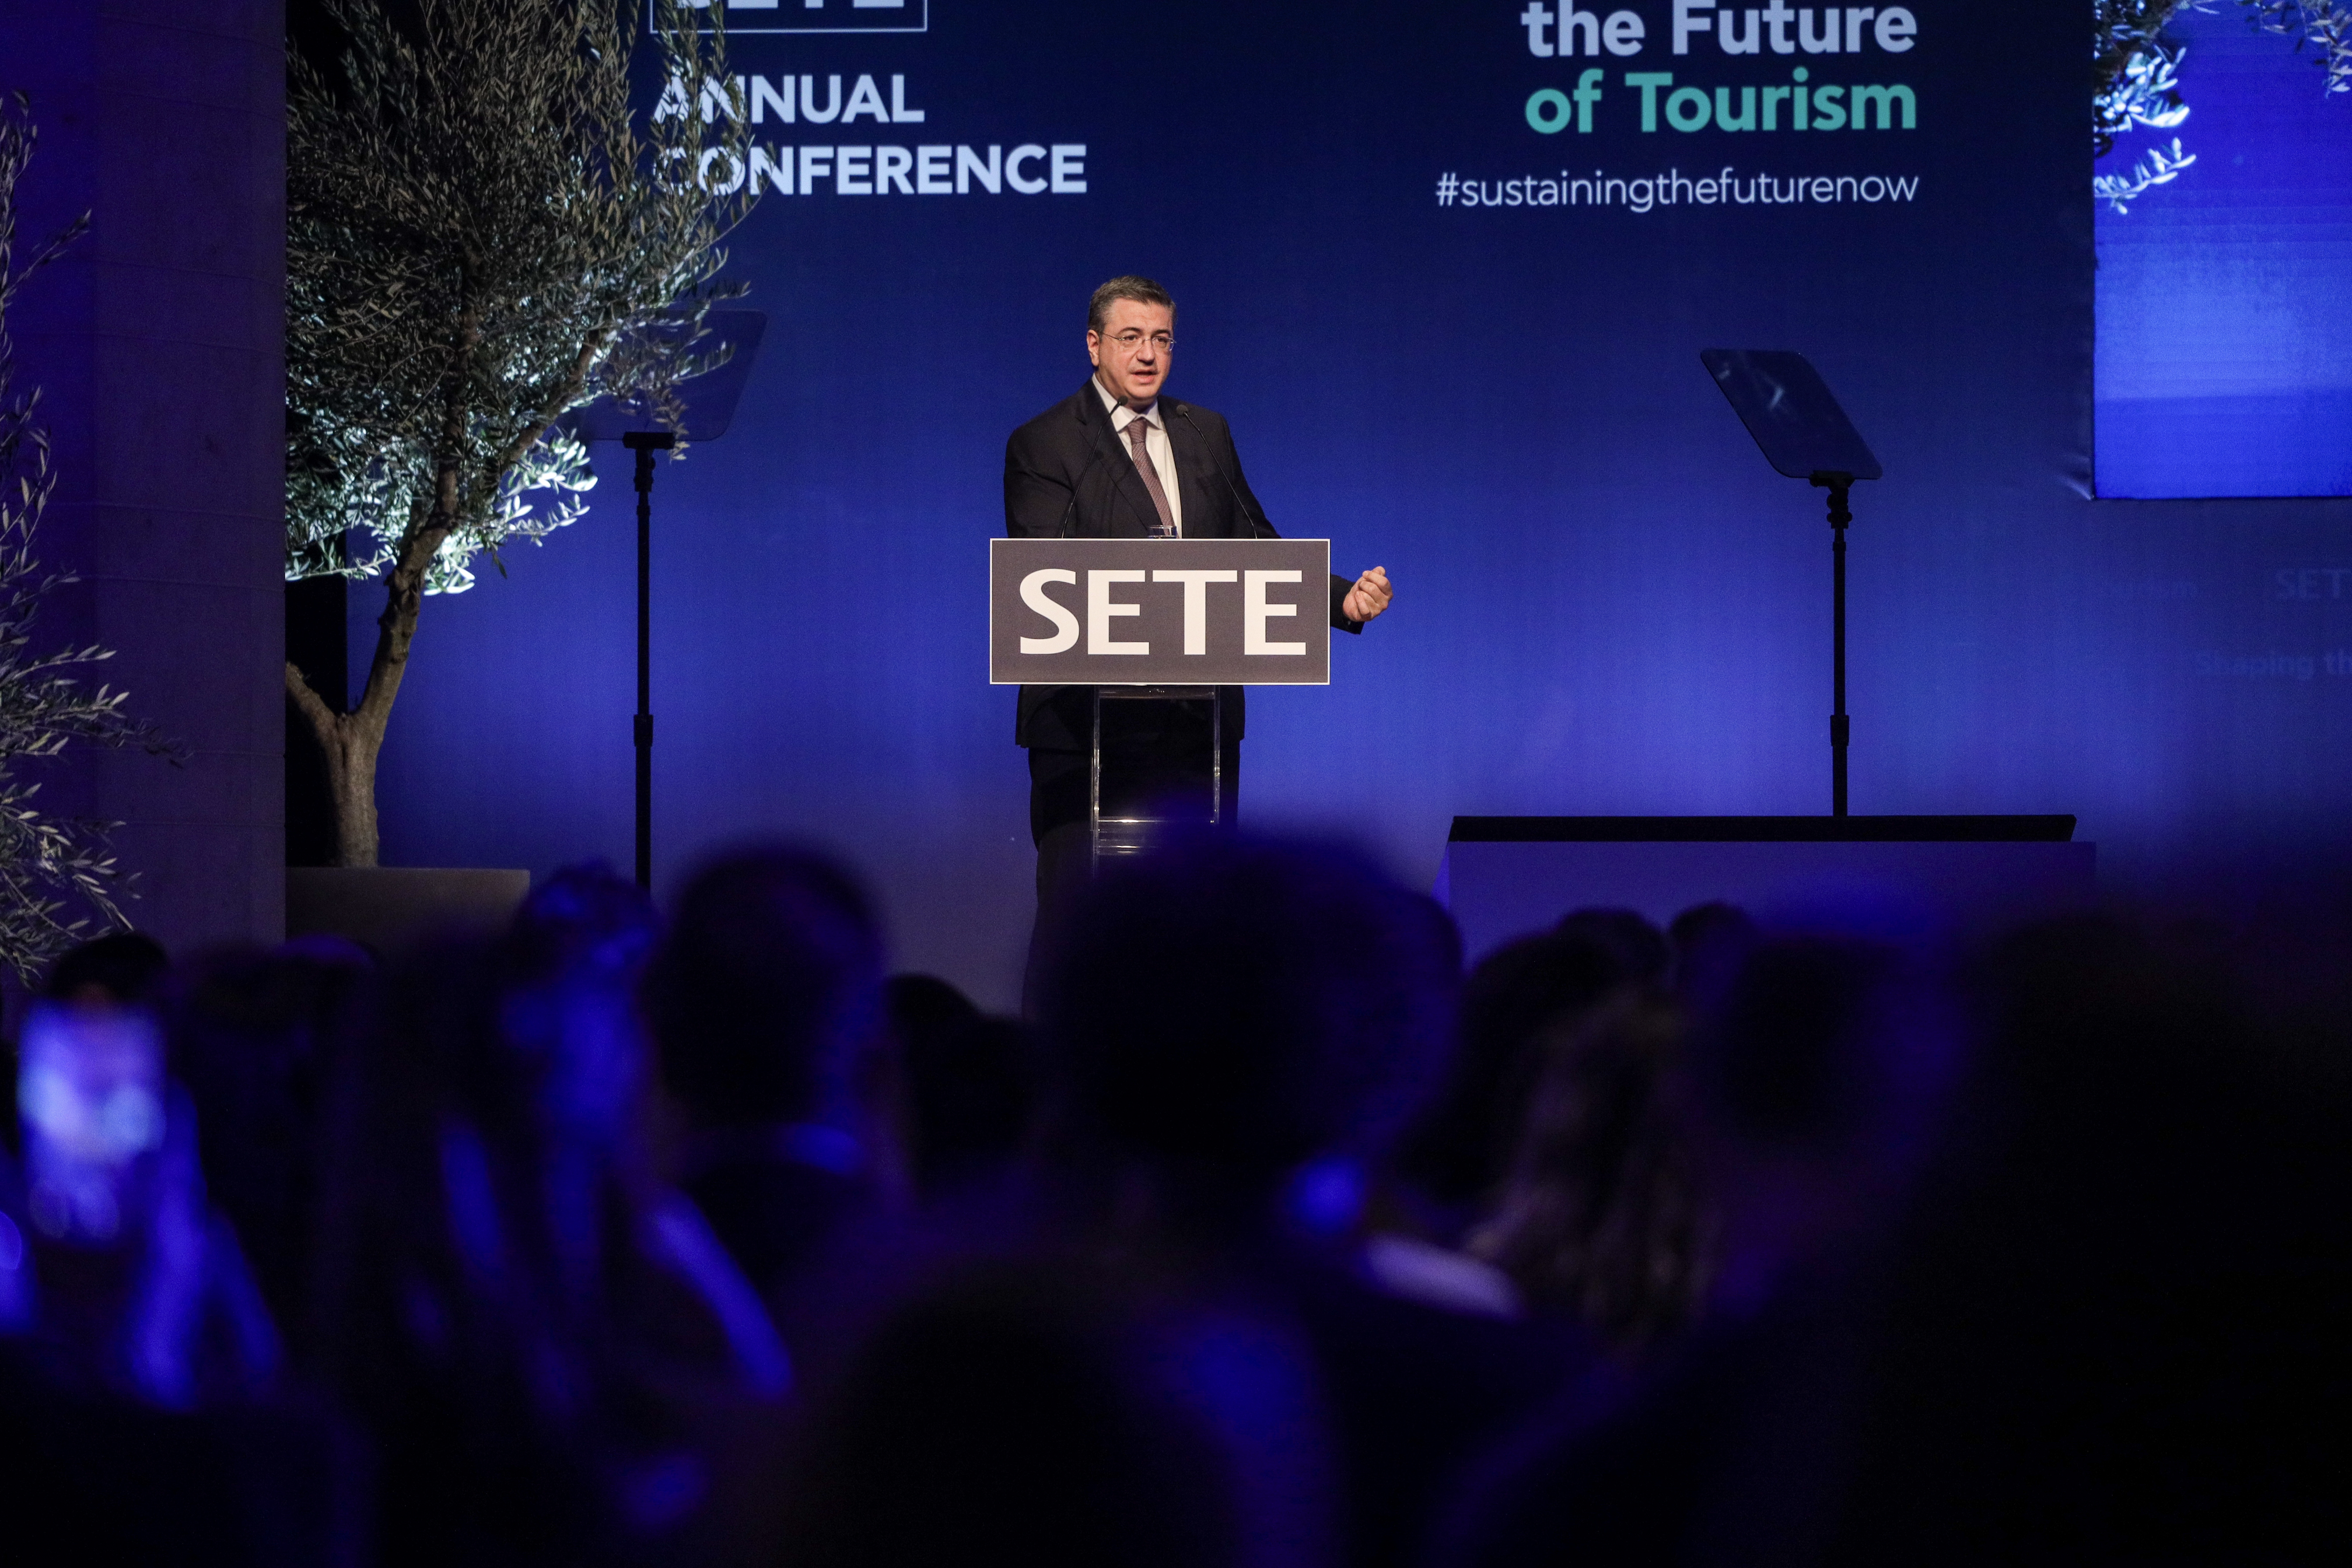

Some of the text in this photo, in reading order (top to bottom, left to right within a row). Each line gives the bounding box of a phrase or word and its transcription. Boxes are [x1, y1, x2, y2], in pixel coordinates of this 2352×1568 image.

[1521, 0, 1917, 57] the Future
[653, 75, 925, 123] ANNUAL
[1525, 66, 1916, 134] of Tourism
[1436, 167, 1918, 212] #sustainingthefuturenow
[1020, 569, 1306, 655] SETE
